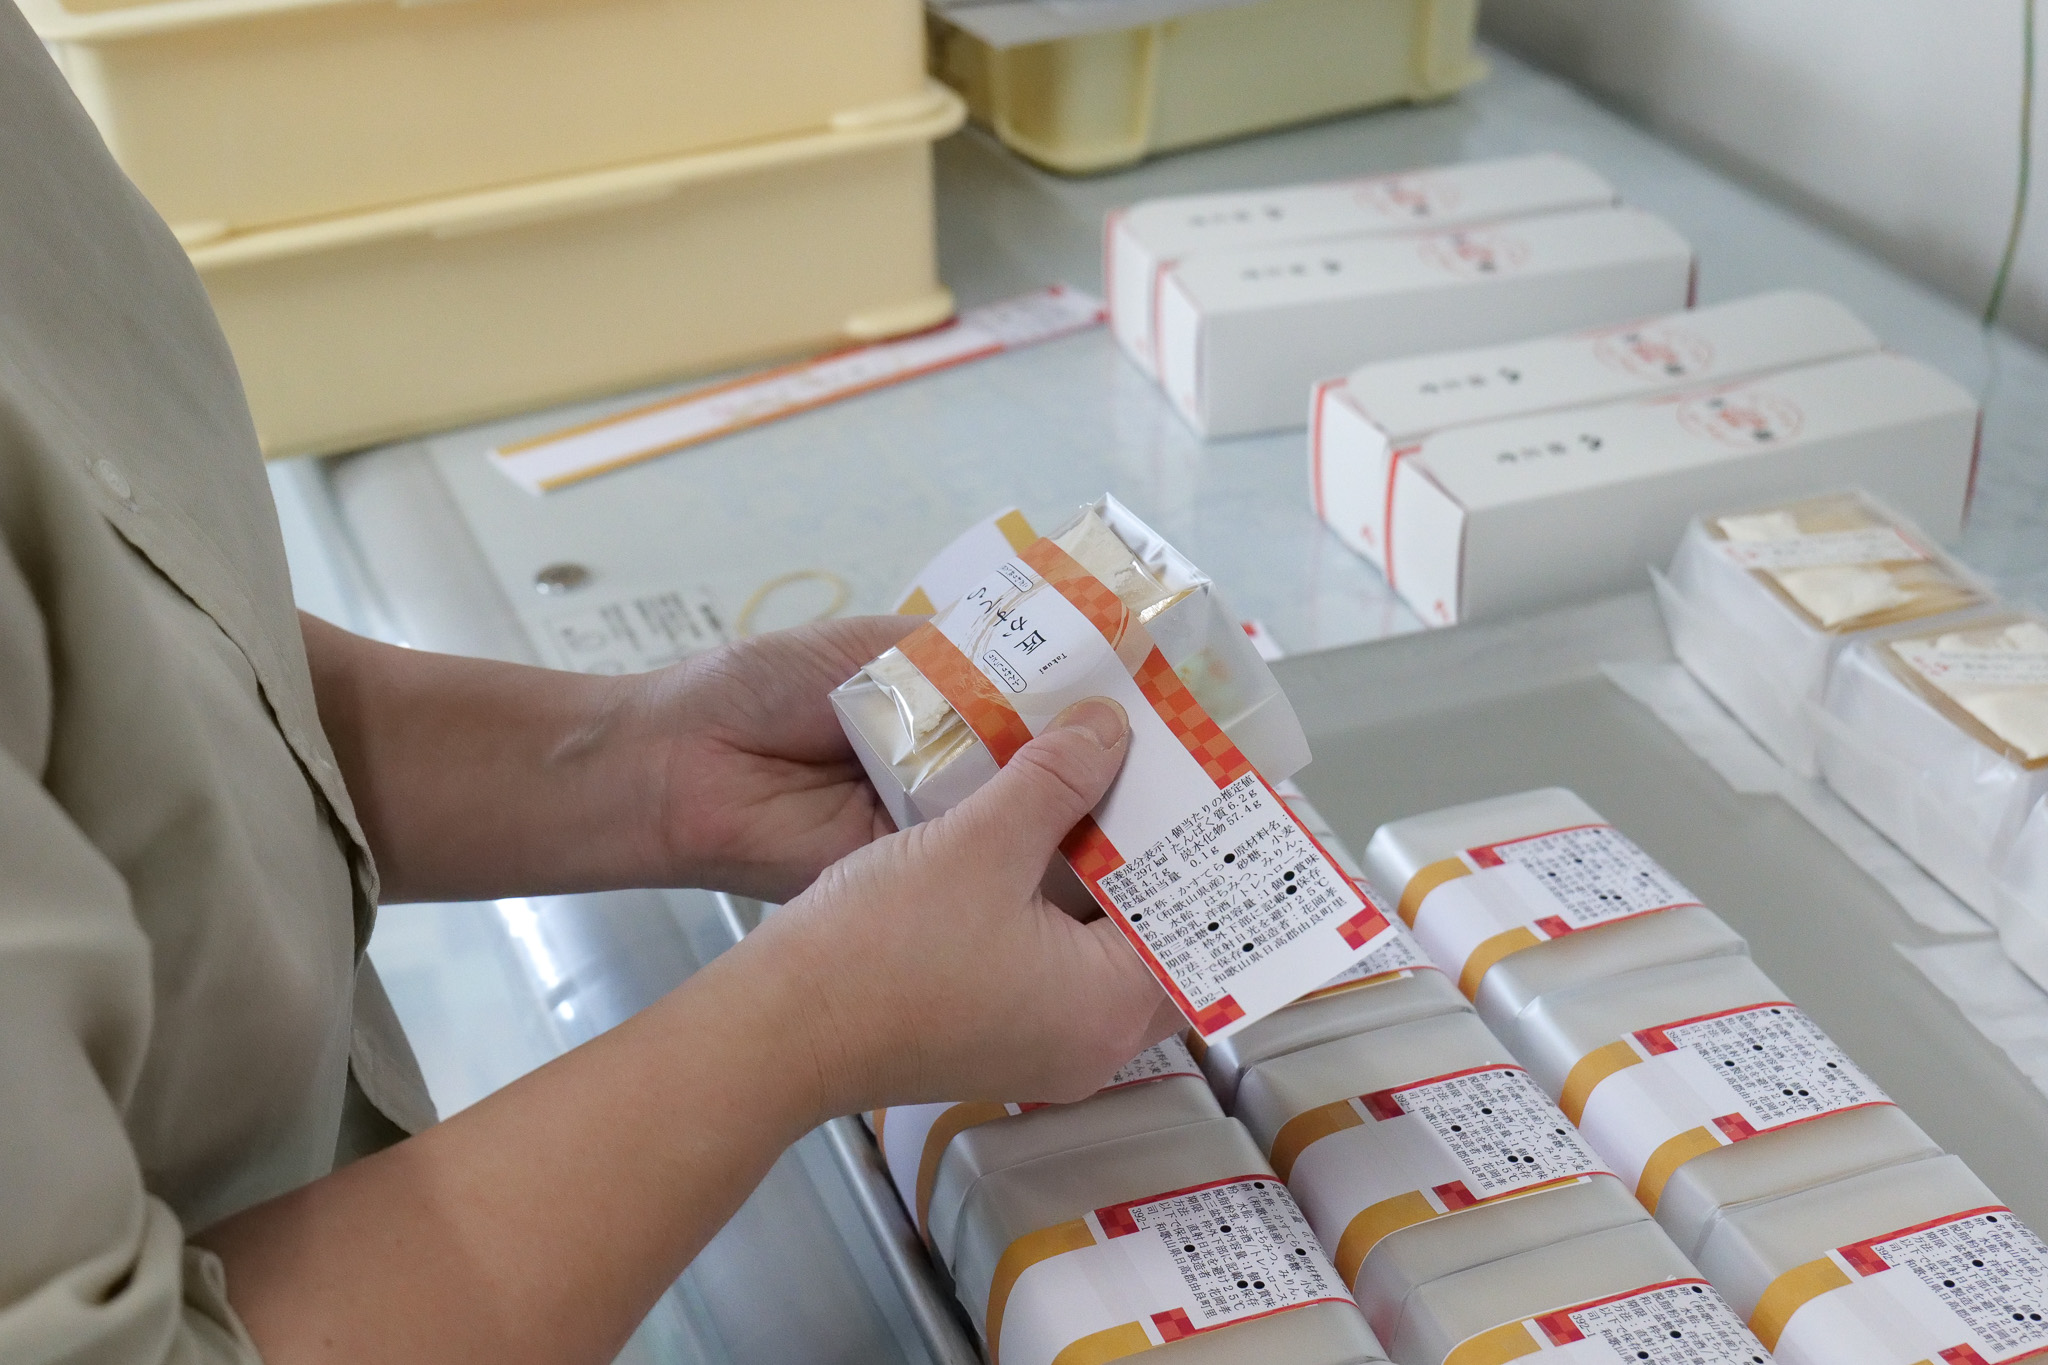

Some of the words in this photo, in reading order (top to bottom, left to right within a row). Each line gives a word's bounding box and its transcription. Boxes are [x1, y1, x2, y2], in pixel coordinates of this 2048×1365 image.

[967, 587, 1046, 655] 匠かすてら
[1039, 653, 1067, 674] Takumi
[1100, 772, 1256, 889] 栄養成分表示1個当たりの推定値
[1119, 869, 1182, 913] 食塩相当量
[1188, 895, 1348, 998] 司：和歌山県日高郡由良町里
[1194, 985, 1227, 1009] 392-1
[1392, 1093, 1416, 1113] 392-1
[1129, 1208, 1151, 1230] 392-1
[1144, 1205, 1219, 1319] 司：和歌山県日高郡由良町里
[1873, 1245, 1901, 1267] 392-1
[1886, 1242, 2006, 1353] 司：和歌山県日高郡由良町里
[1570, 1313, 1596, 1337] 392-1
